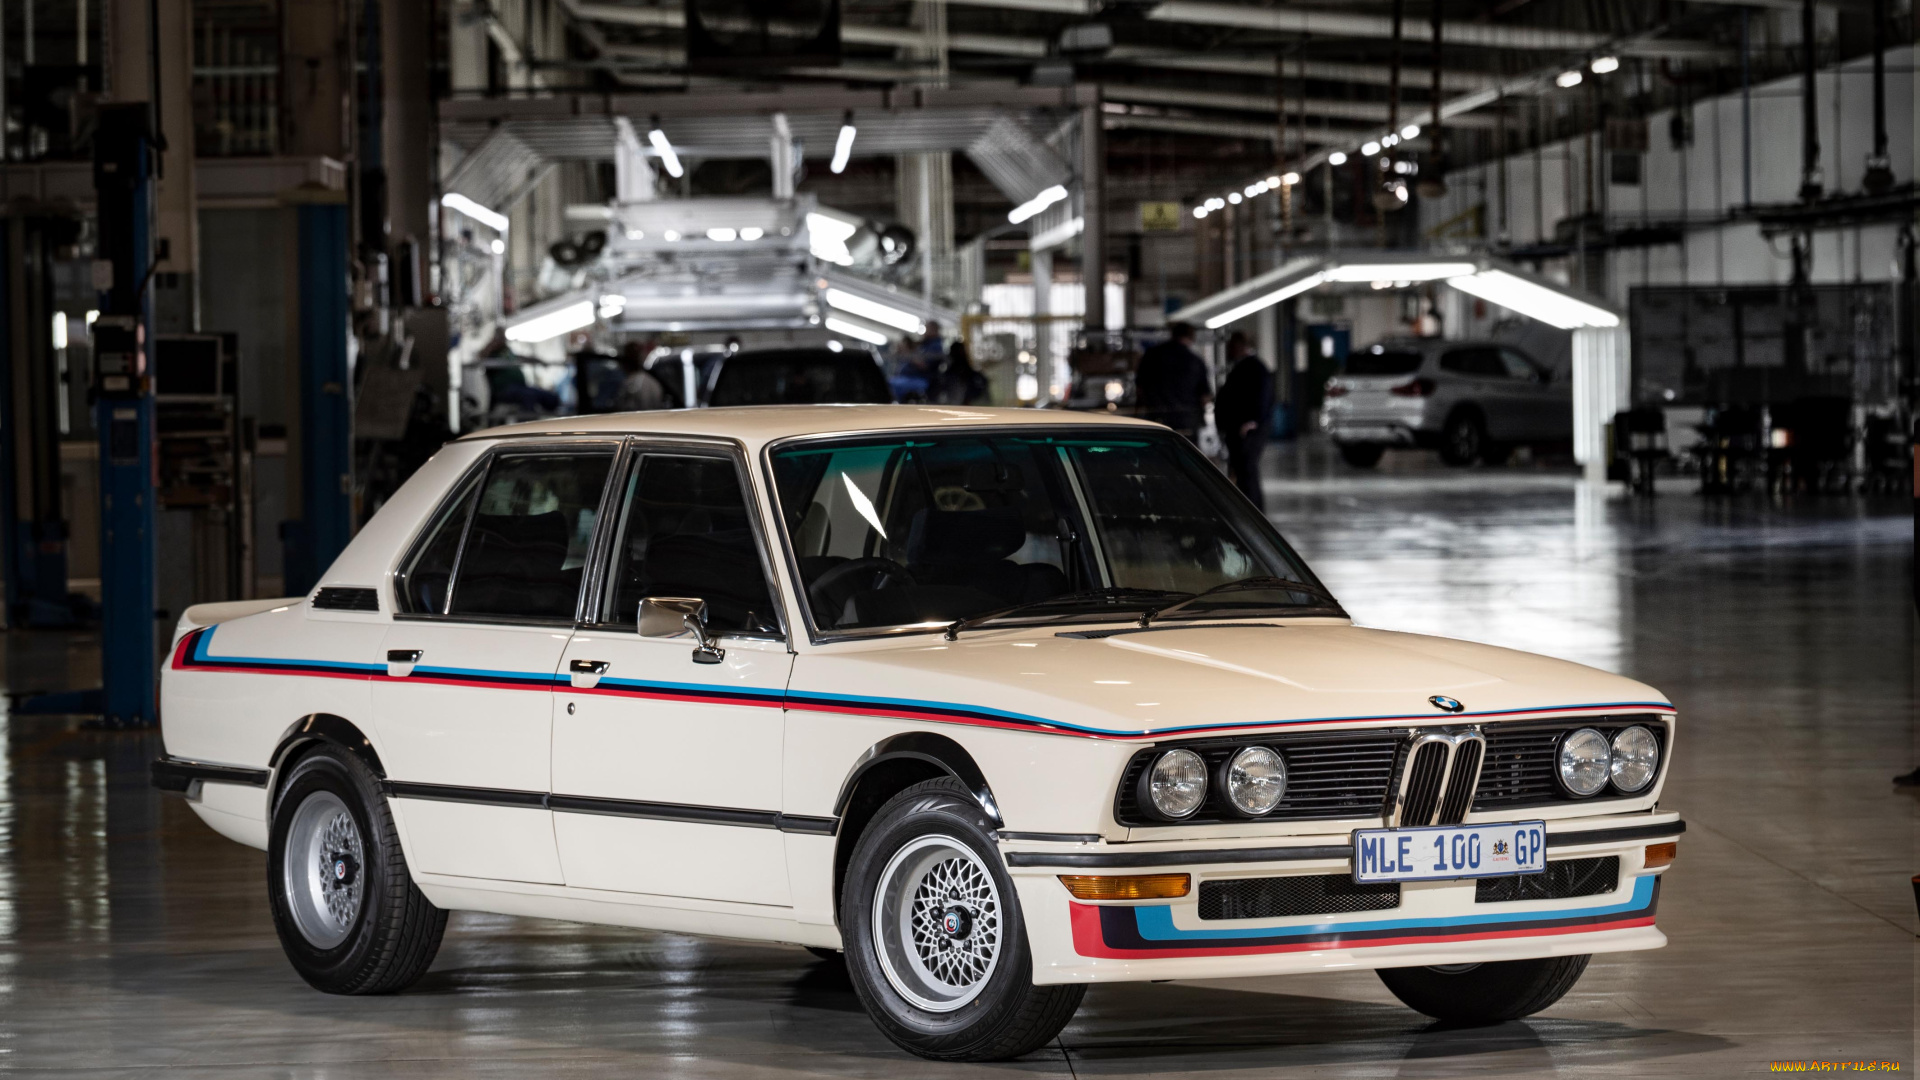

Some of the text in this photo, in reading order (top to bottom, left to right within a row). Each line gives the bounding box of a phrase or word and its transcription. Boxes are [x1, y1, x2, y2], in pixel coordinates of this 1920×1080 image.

[1361, 829, 1541, 874] MLE 100 GP
